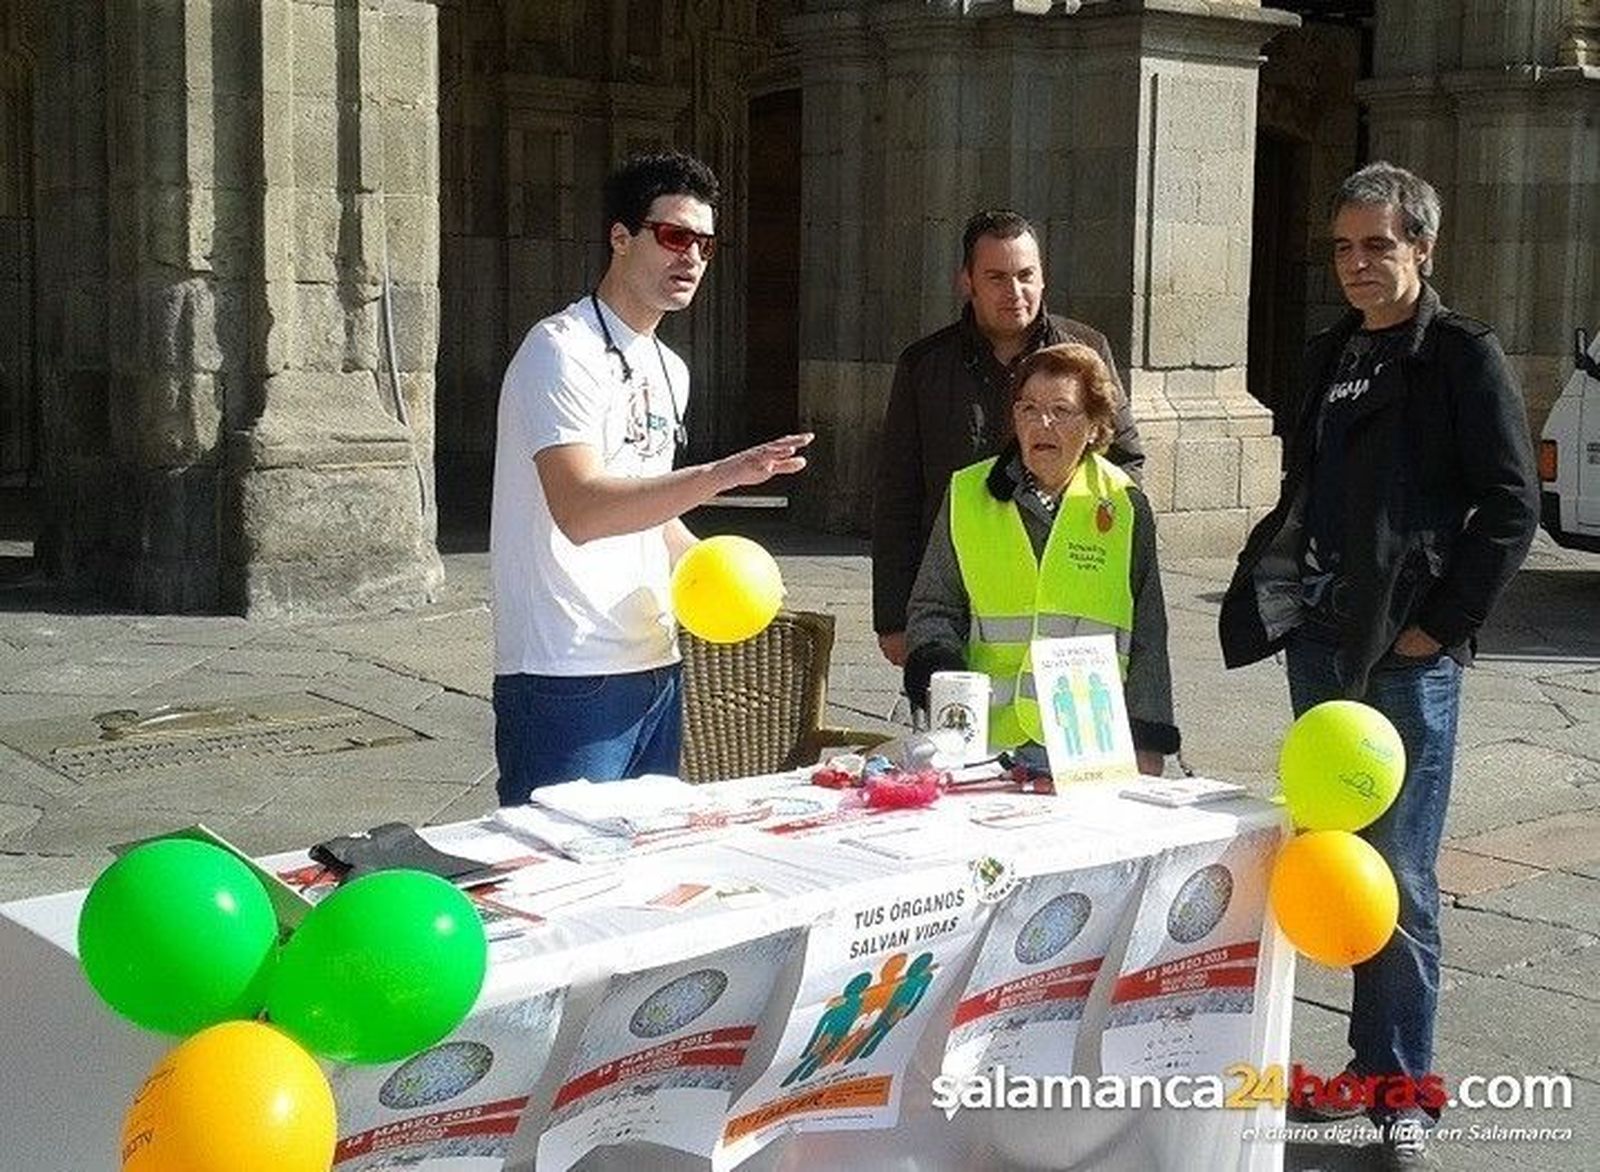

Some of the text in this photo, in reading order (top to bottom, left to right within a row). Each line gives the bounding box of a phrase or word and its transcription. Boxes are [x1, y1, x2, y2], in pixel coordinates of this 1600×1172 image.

[855, 887, 965, 929] TUS ÓRGANOS
[849, 916, 959, 959] SALVAN VIDAS
[372, 1115, 440, 1139] MARZO
